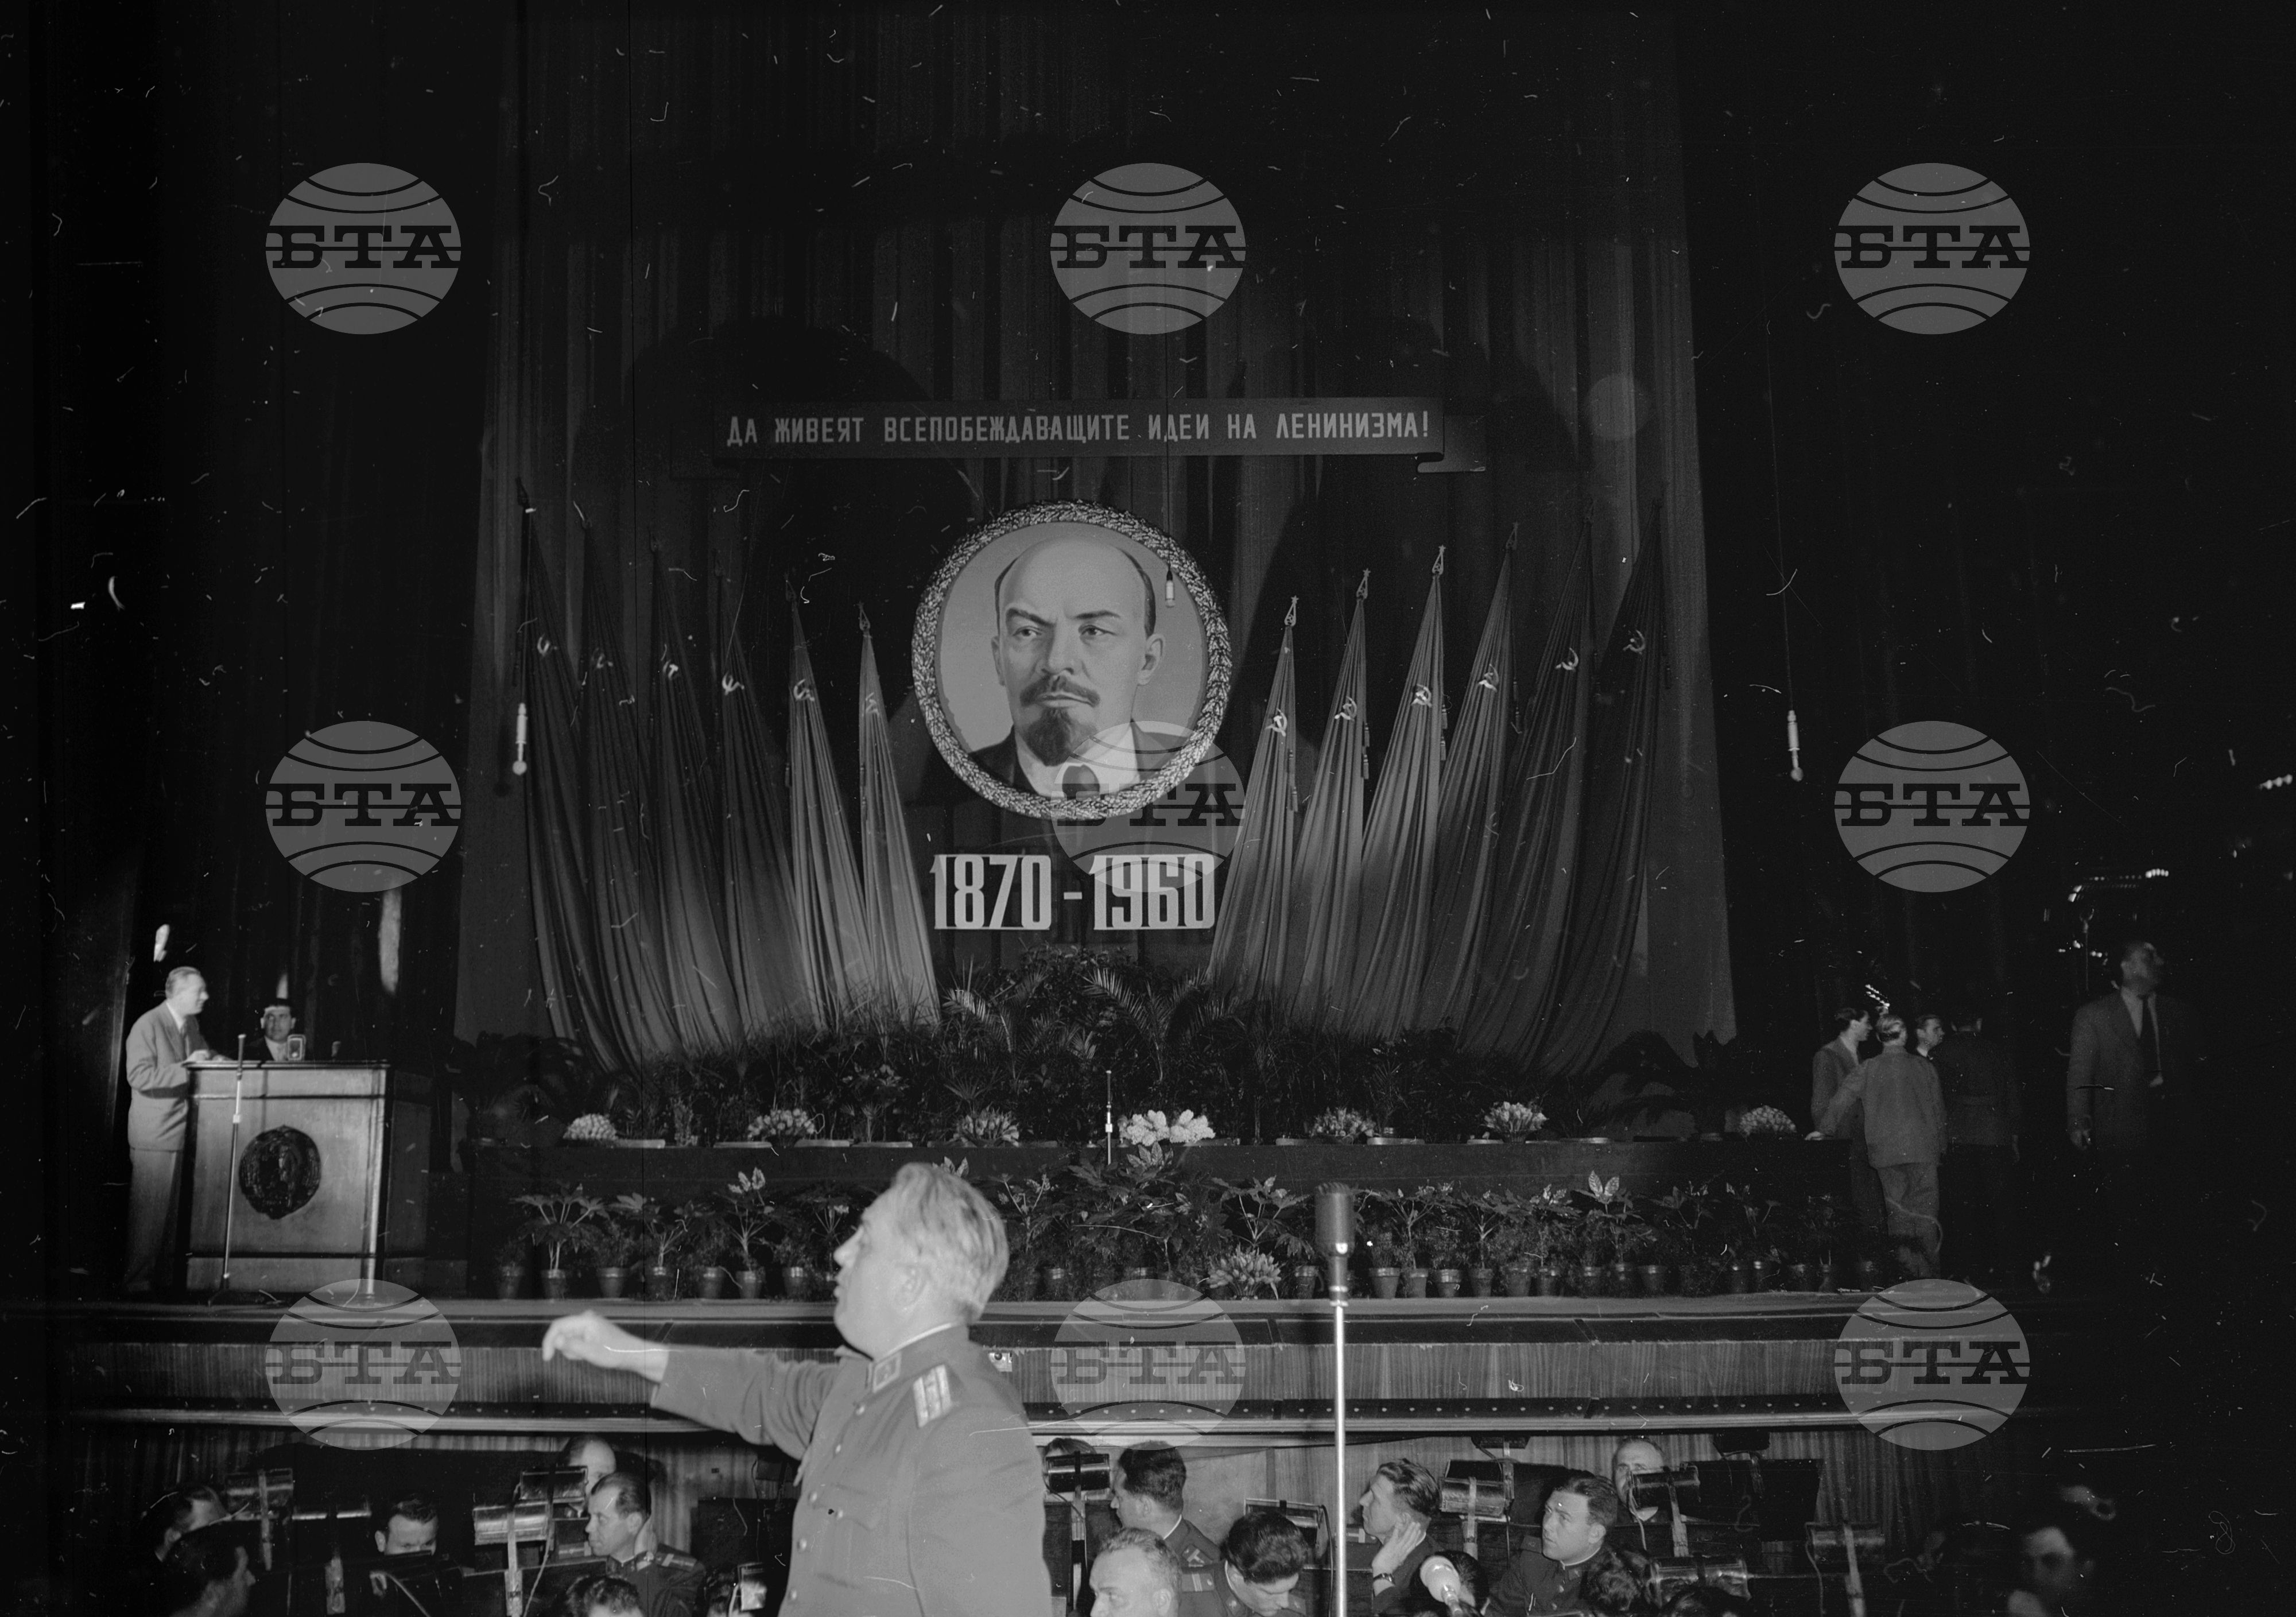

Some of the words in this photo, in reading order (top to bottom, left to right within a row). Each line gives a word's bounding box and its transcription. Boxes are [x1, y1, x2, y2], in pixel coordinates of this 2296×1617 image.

[727, 416, 758, 447] ДА
[775, 417, 864, 443] ЖИВЕЯТ
[884, 414, 1130, 444] ВСЕПОБЕЖДАВАЩИТЕ
[1148, 414, 1209, 443] ИДЕИ
[1227, 413, 1257, 440] НА
[1276, 410, 1429, 439] ЛЕНИНИЗМА!
